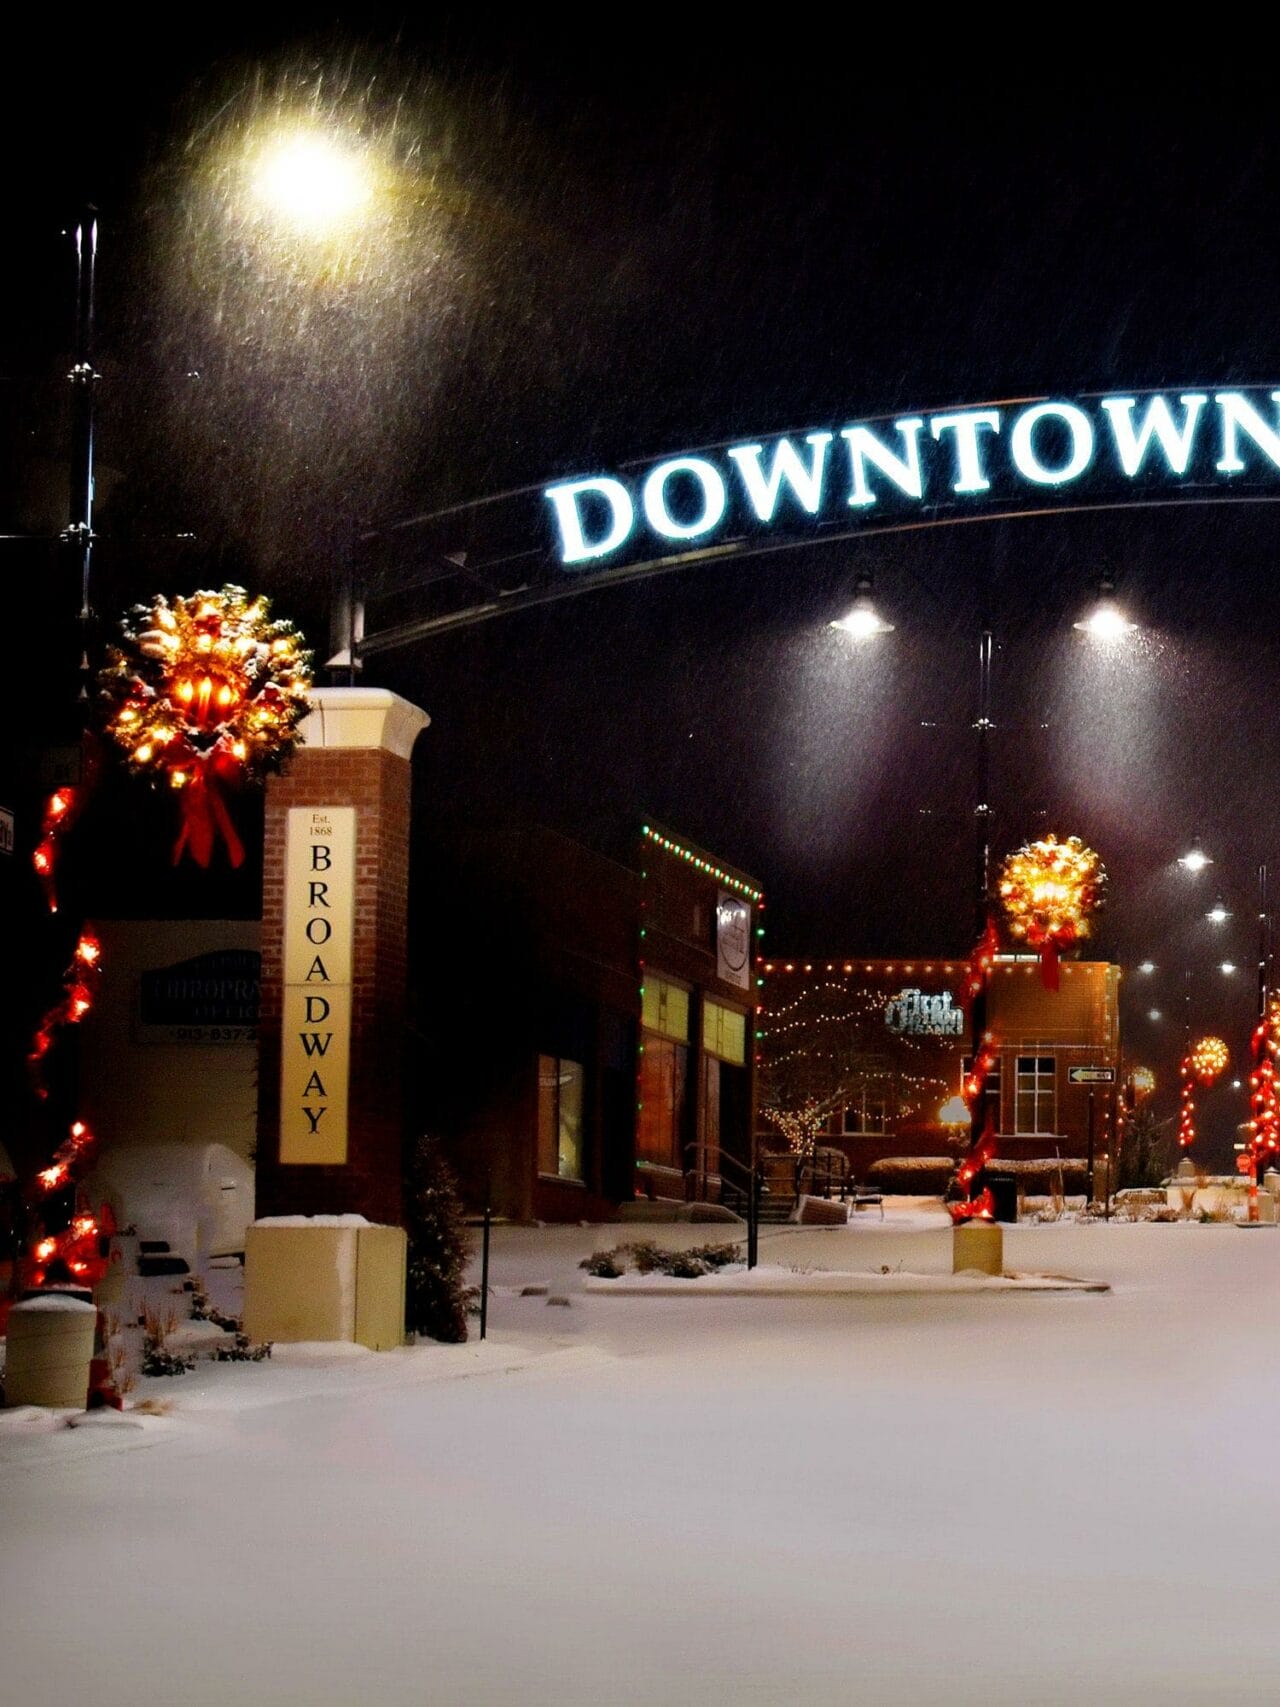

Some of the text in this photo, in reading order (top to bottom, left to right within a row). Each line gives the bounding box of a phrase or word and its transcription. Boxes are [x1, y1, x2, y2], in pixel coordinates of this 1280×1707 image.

[312, 813, 331, 824] Est.
[309, 826, 333, 836] 1868
[299, 845, 334, 1134] BROADWAY
[901, 988, 953, 1013] First
